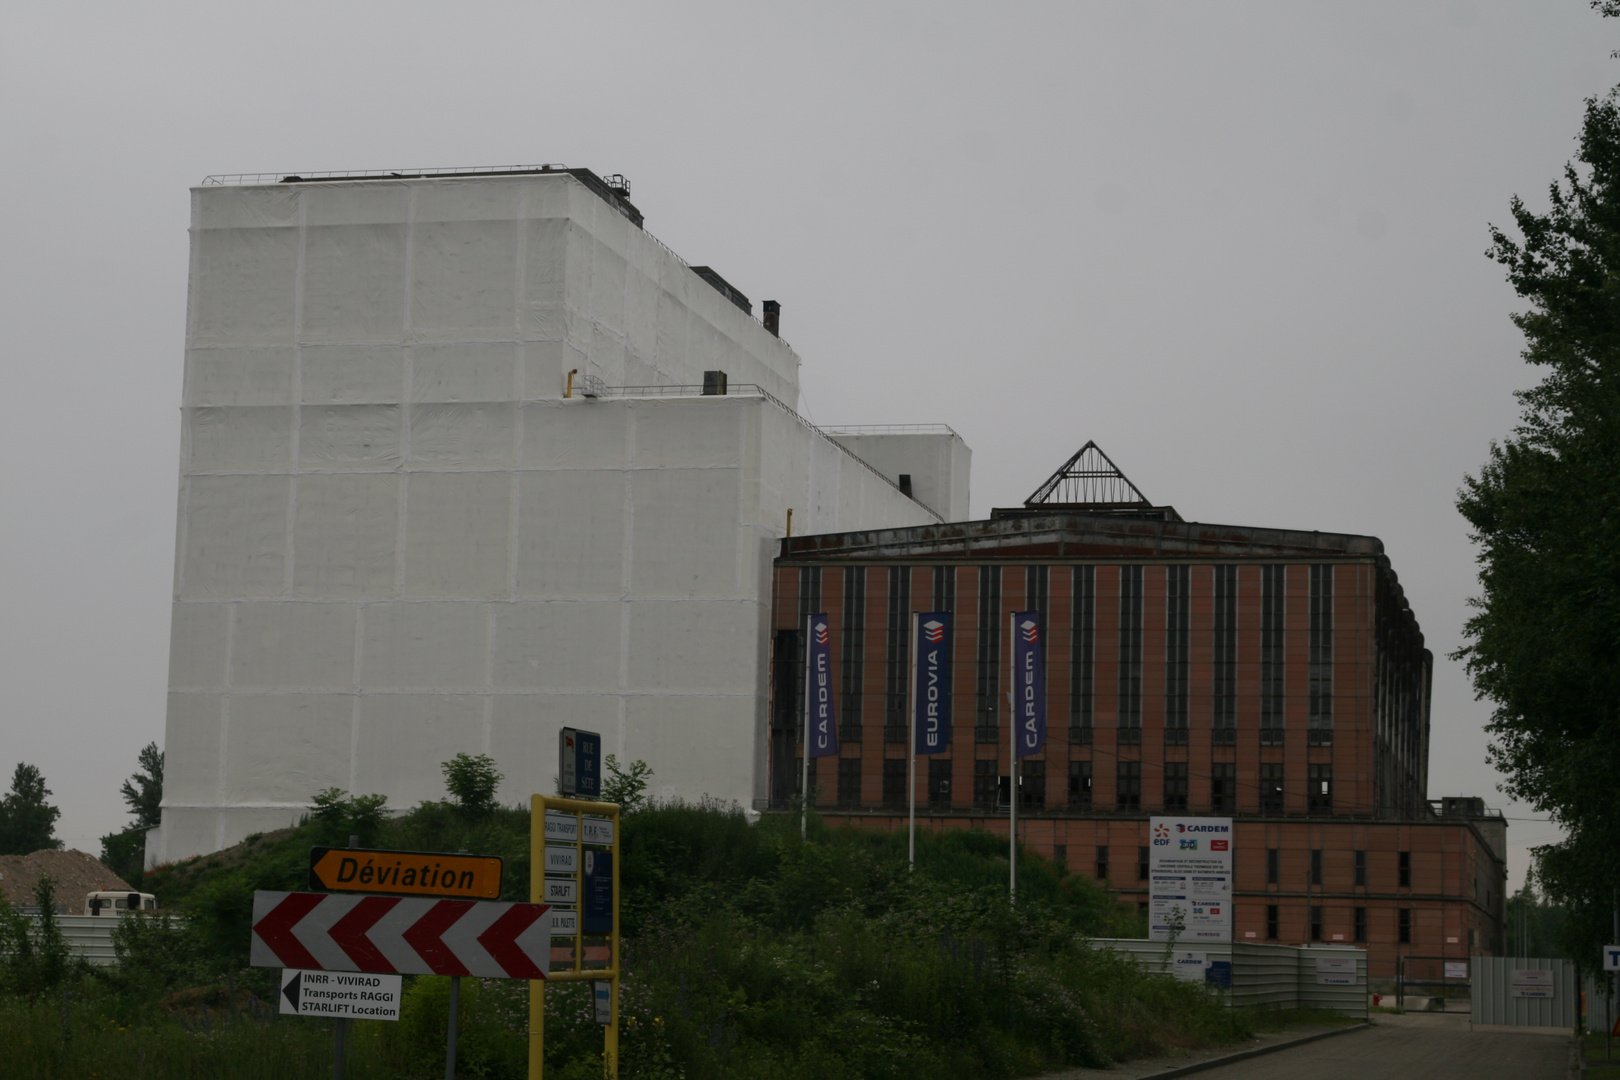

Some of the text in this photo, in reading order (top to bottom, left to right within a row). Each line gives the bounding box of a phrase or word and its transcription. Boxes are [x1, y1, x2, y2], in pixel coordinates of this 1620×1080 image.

[817, 653, 828, 749] CARDEM
[927, 650, 938, 747] EUROVIA
[1025, 651, 1038, 748] CARDEM
[582, 742, 594, 755] RUE
[584, 760, 593, 771] DE
[1187, 825, 1229, 833] CARDEM
[550, 854, 572, 866] VIVIRAD
[337, 857, 475, 889] Déviation
[550, 885, 570, 897] STARLIFT
[304, 974, 329, 984] INRR
[337, 976, 380, 987] VIVIRAD
[303, 988, 393, 1002] Transports RAGGI
[302, 1002, 396, 1016] STARLIFT Location
